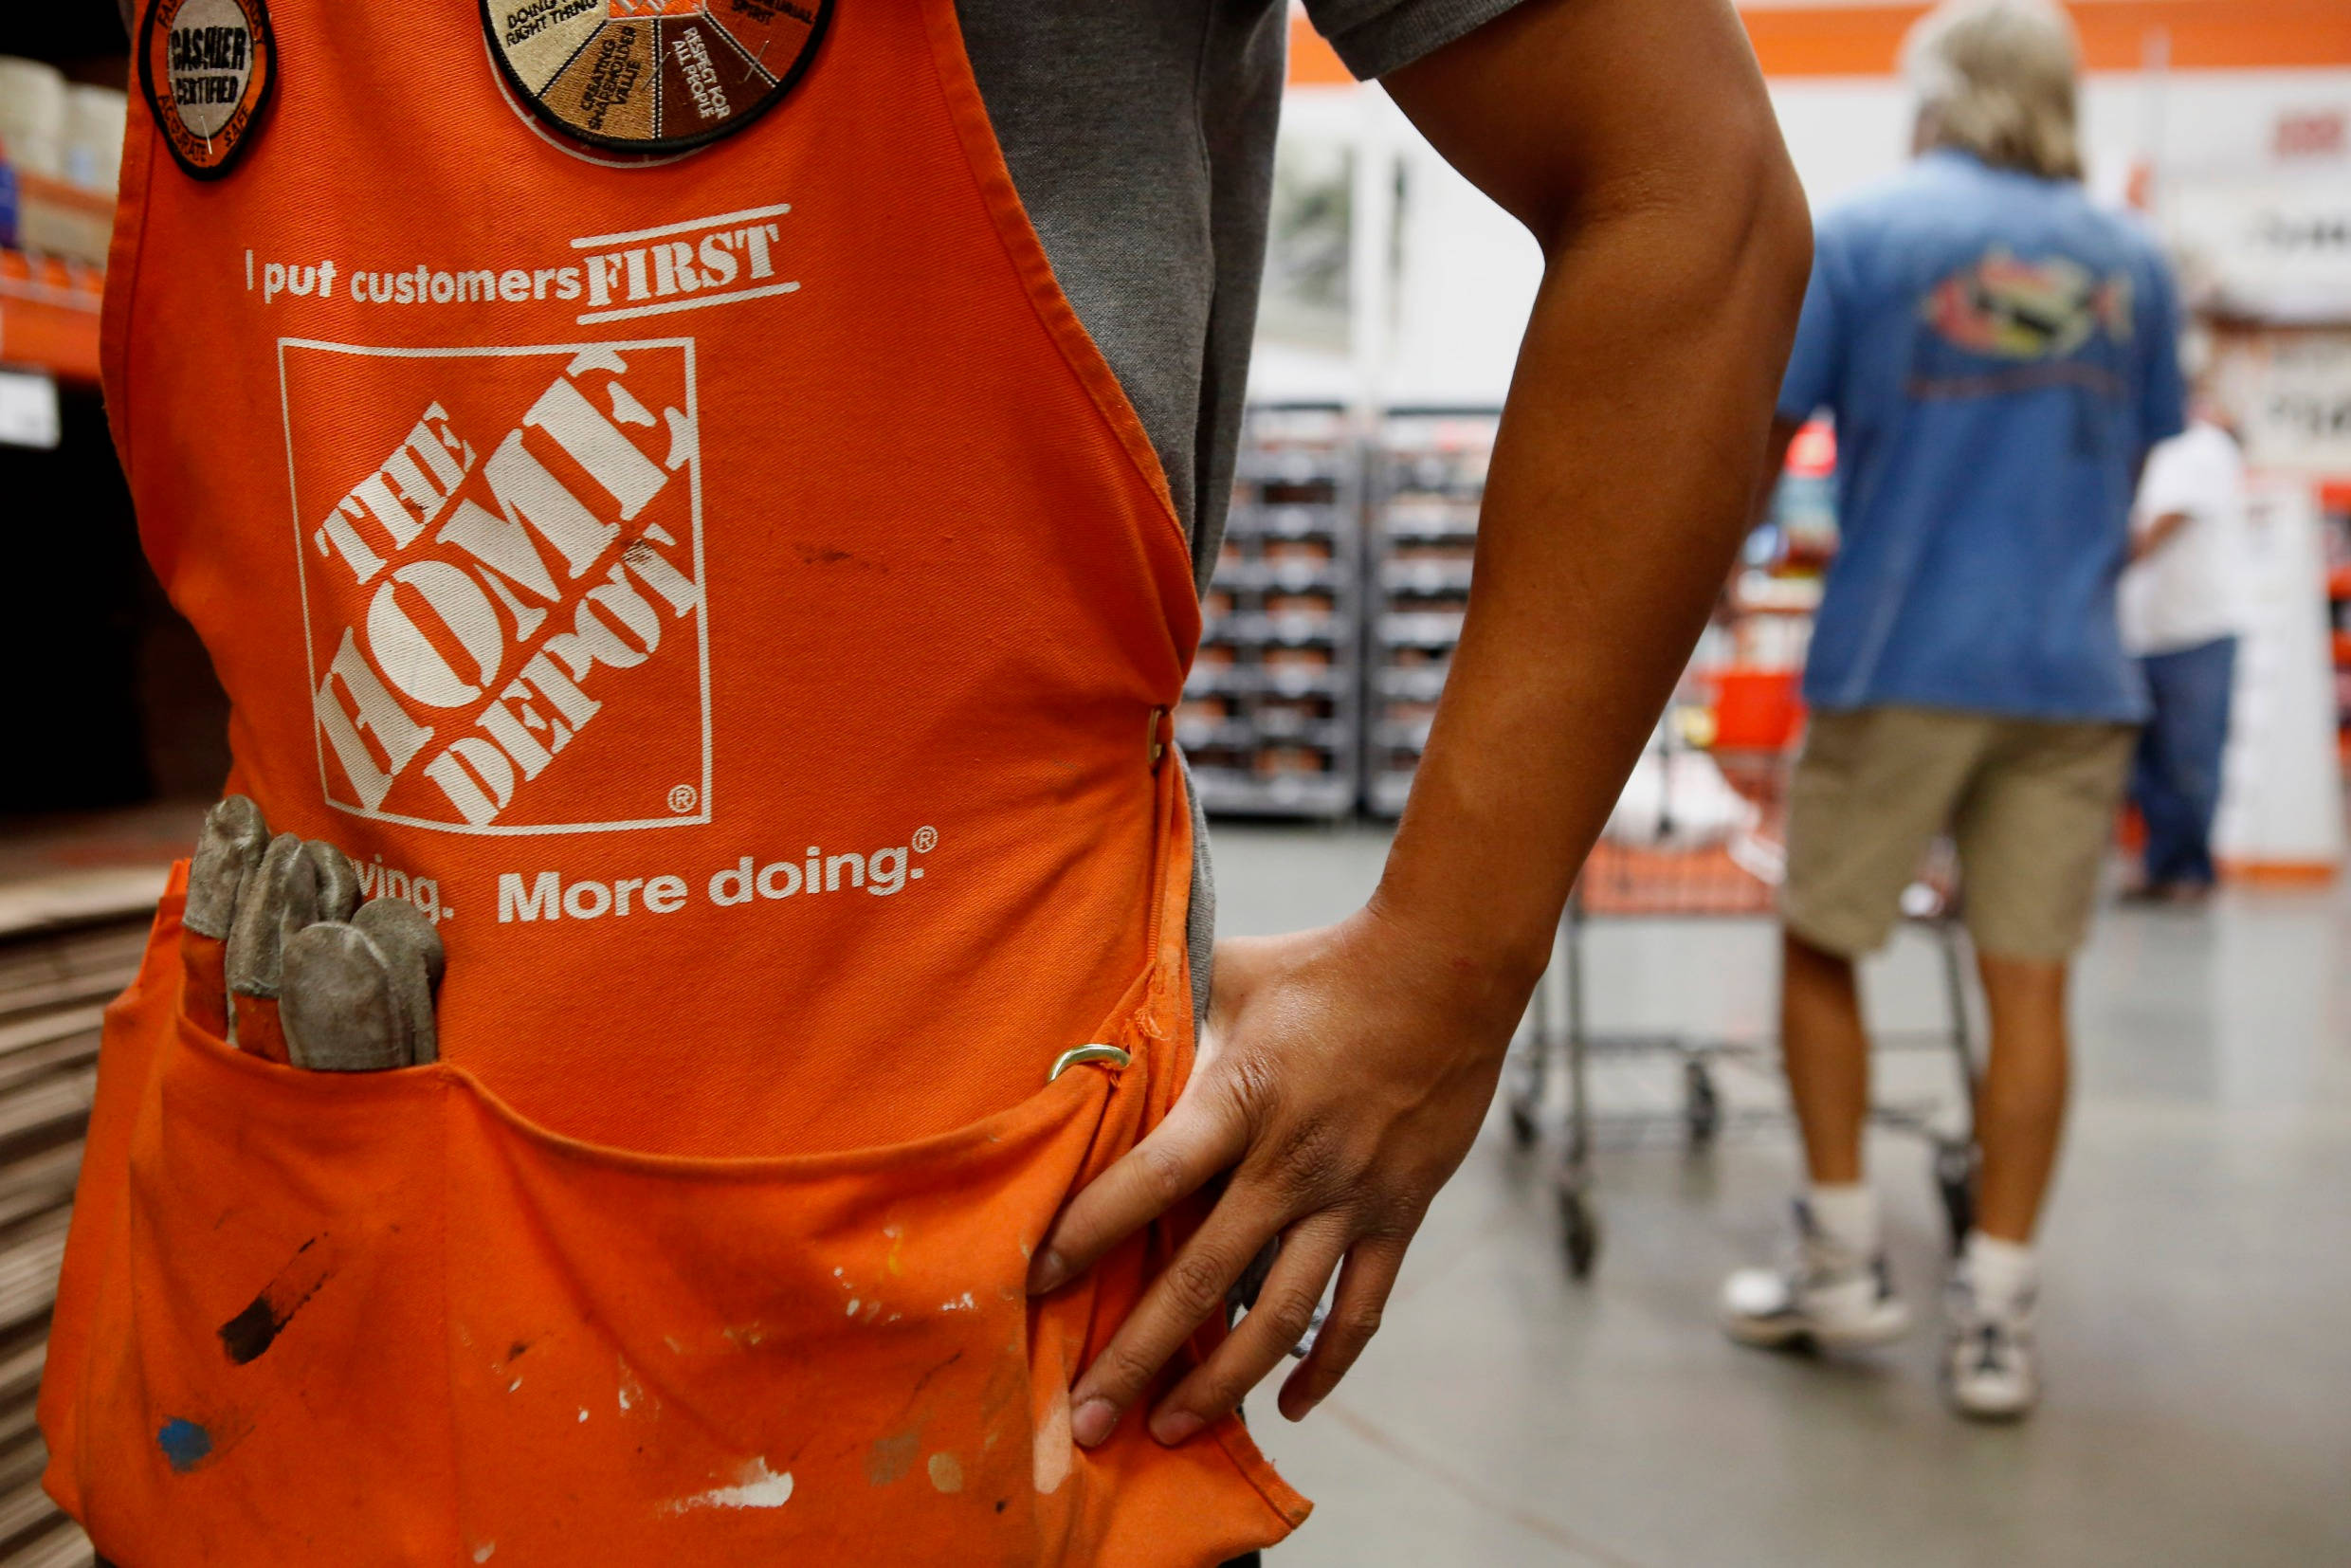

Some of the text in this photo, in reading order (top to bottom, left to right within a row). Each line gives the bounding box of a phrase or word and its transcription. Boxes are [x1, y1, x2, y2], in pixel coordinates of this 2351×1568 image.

[171, 26, 248, 71] CASHIER
[506, 14, 547, 47] RIGHT
[175, 76, 239, 105] CERTIFIED
[581, 39, 615, 111] CREATING
[588, 27, 636, 130] SHAREHOLDER
[608, 60, 641, 105] VALUE
[672, 41, 716, 119] ALL PEOPLE
[683, 27, 731, 120] RESPECT FOR
[245, 224, 780, 306] I put customers FIRST
[314, 400, 477, 586] THE
[315, 349, 690, 811] HOME
[423, 523, 697, 827] DEPOT
[346, 853, 455, 926] ving.
[498, 871, 688, 923] More
